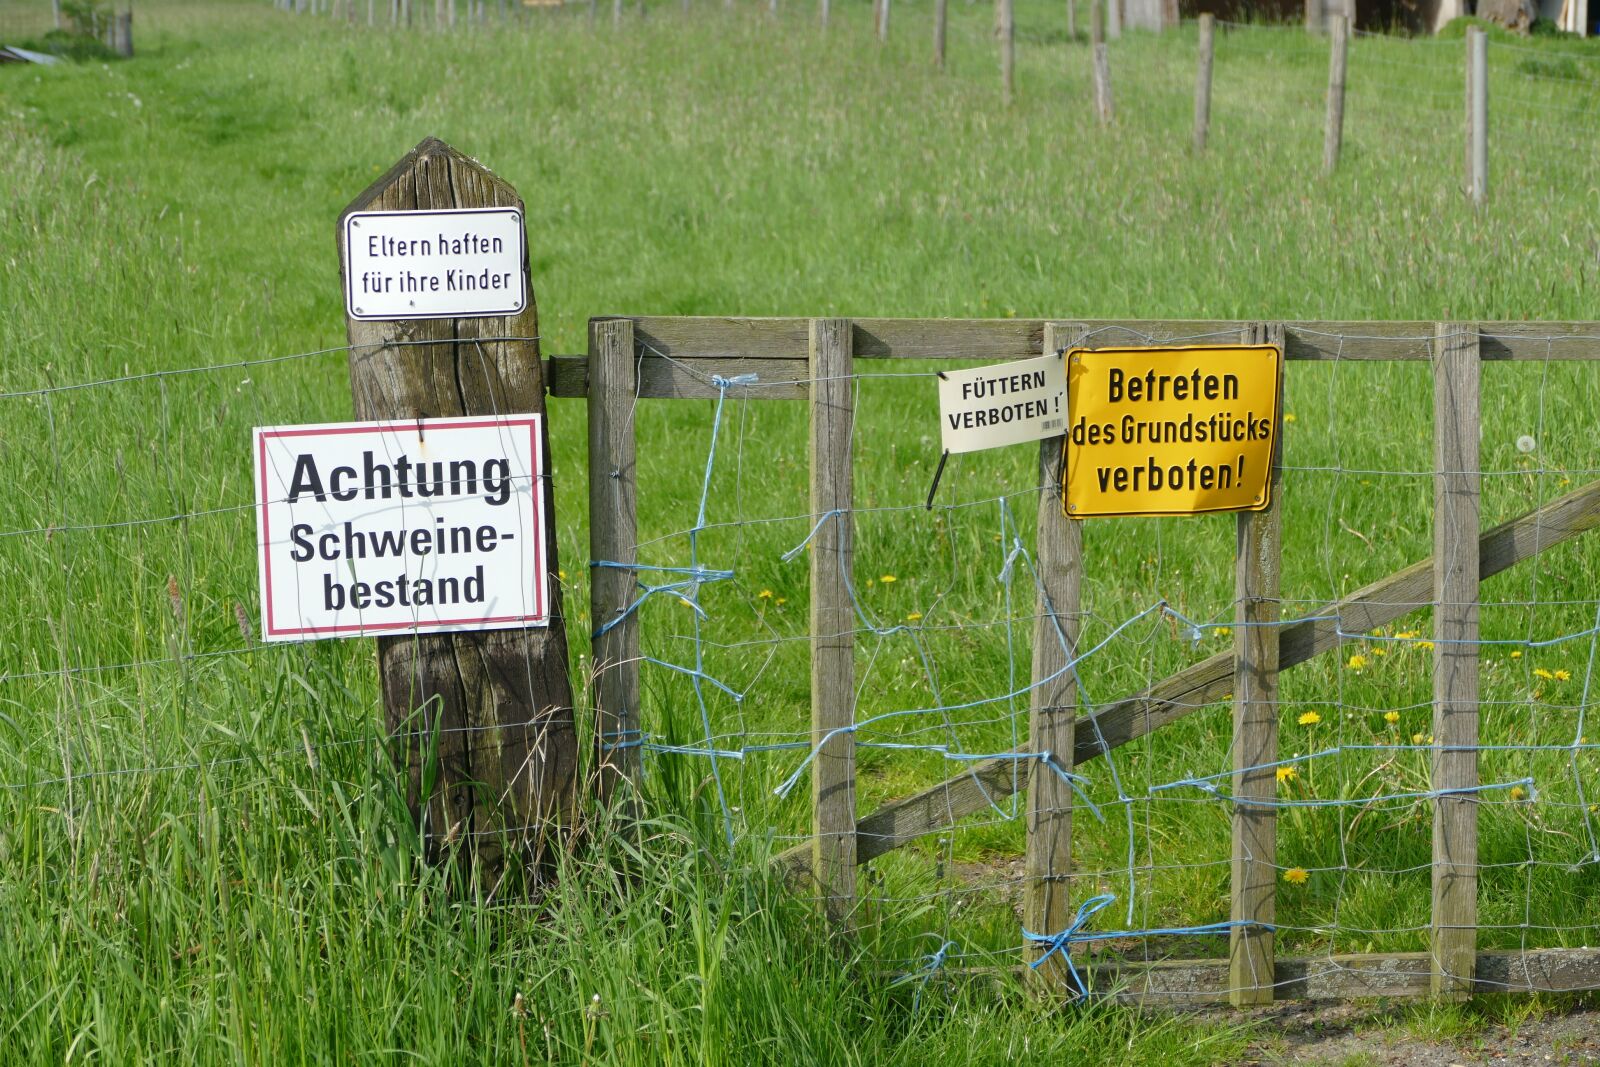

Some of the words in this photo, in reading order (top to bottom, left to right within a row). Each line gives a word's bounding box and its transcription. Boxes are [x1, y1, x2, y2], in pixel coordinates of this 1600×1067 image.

[368, 234, 431, 258] Eltern
[439, 233, 503, 256] haften
[362, 271, 392, 294] für
[399, 269, 440, 293] ihre
[447, 268, 512, 291] Kinder
[962, 370, 1046, 400] FÜTTERN
[1108, 367, 1239, 403] Betreten
[948, 399, 1048, 431] VERBOTEN
[1072, 416, 1116, 446] des
[1121, 411, 1270, 444] Grundstücks
[288, 450, 511, 506] Achtung
[1096, 454, 1245, 494] verboten!
[289, 516, 515, 564] Schweine-
[323, 564, 486, 611] bestand
